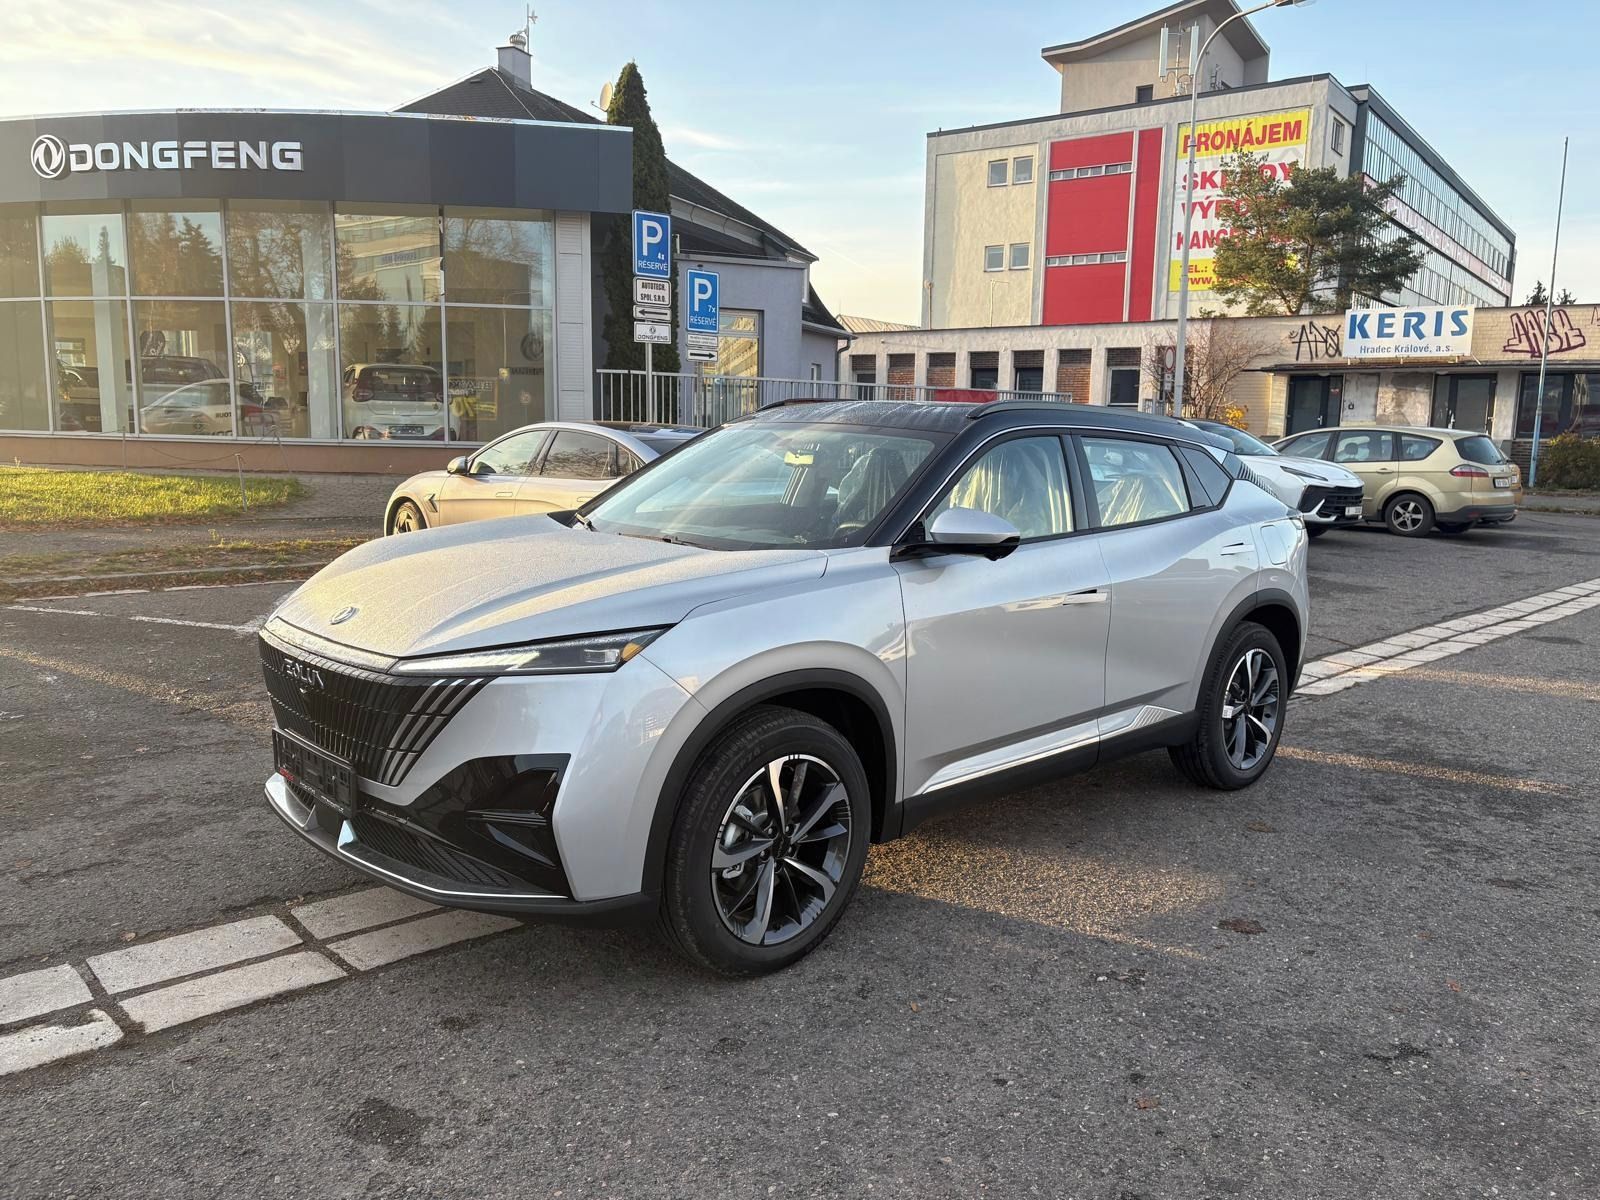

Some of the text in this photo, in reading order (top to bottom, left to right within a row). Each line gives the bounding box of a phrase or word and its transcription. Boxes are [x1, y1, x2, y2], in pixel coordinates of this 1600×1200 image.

[1182, 119, 1302, 154] PRONÁJEM
[69, 140, 302, 172] DONGFENG
[642, 220, 663, 256] P
[694, 277, 712, 312] P
[707, 304, 716, 313] 7x
[690, 314, 717, 326] RÉSERVÉ
[1348, 310, 1469, 340] KERIS
[1359, 345, 1392, 354] Hradec
[1394, 343, 1433, 353] Králové,
